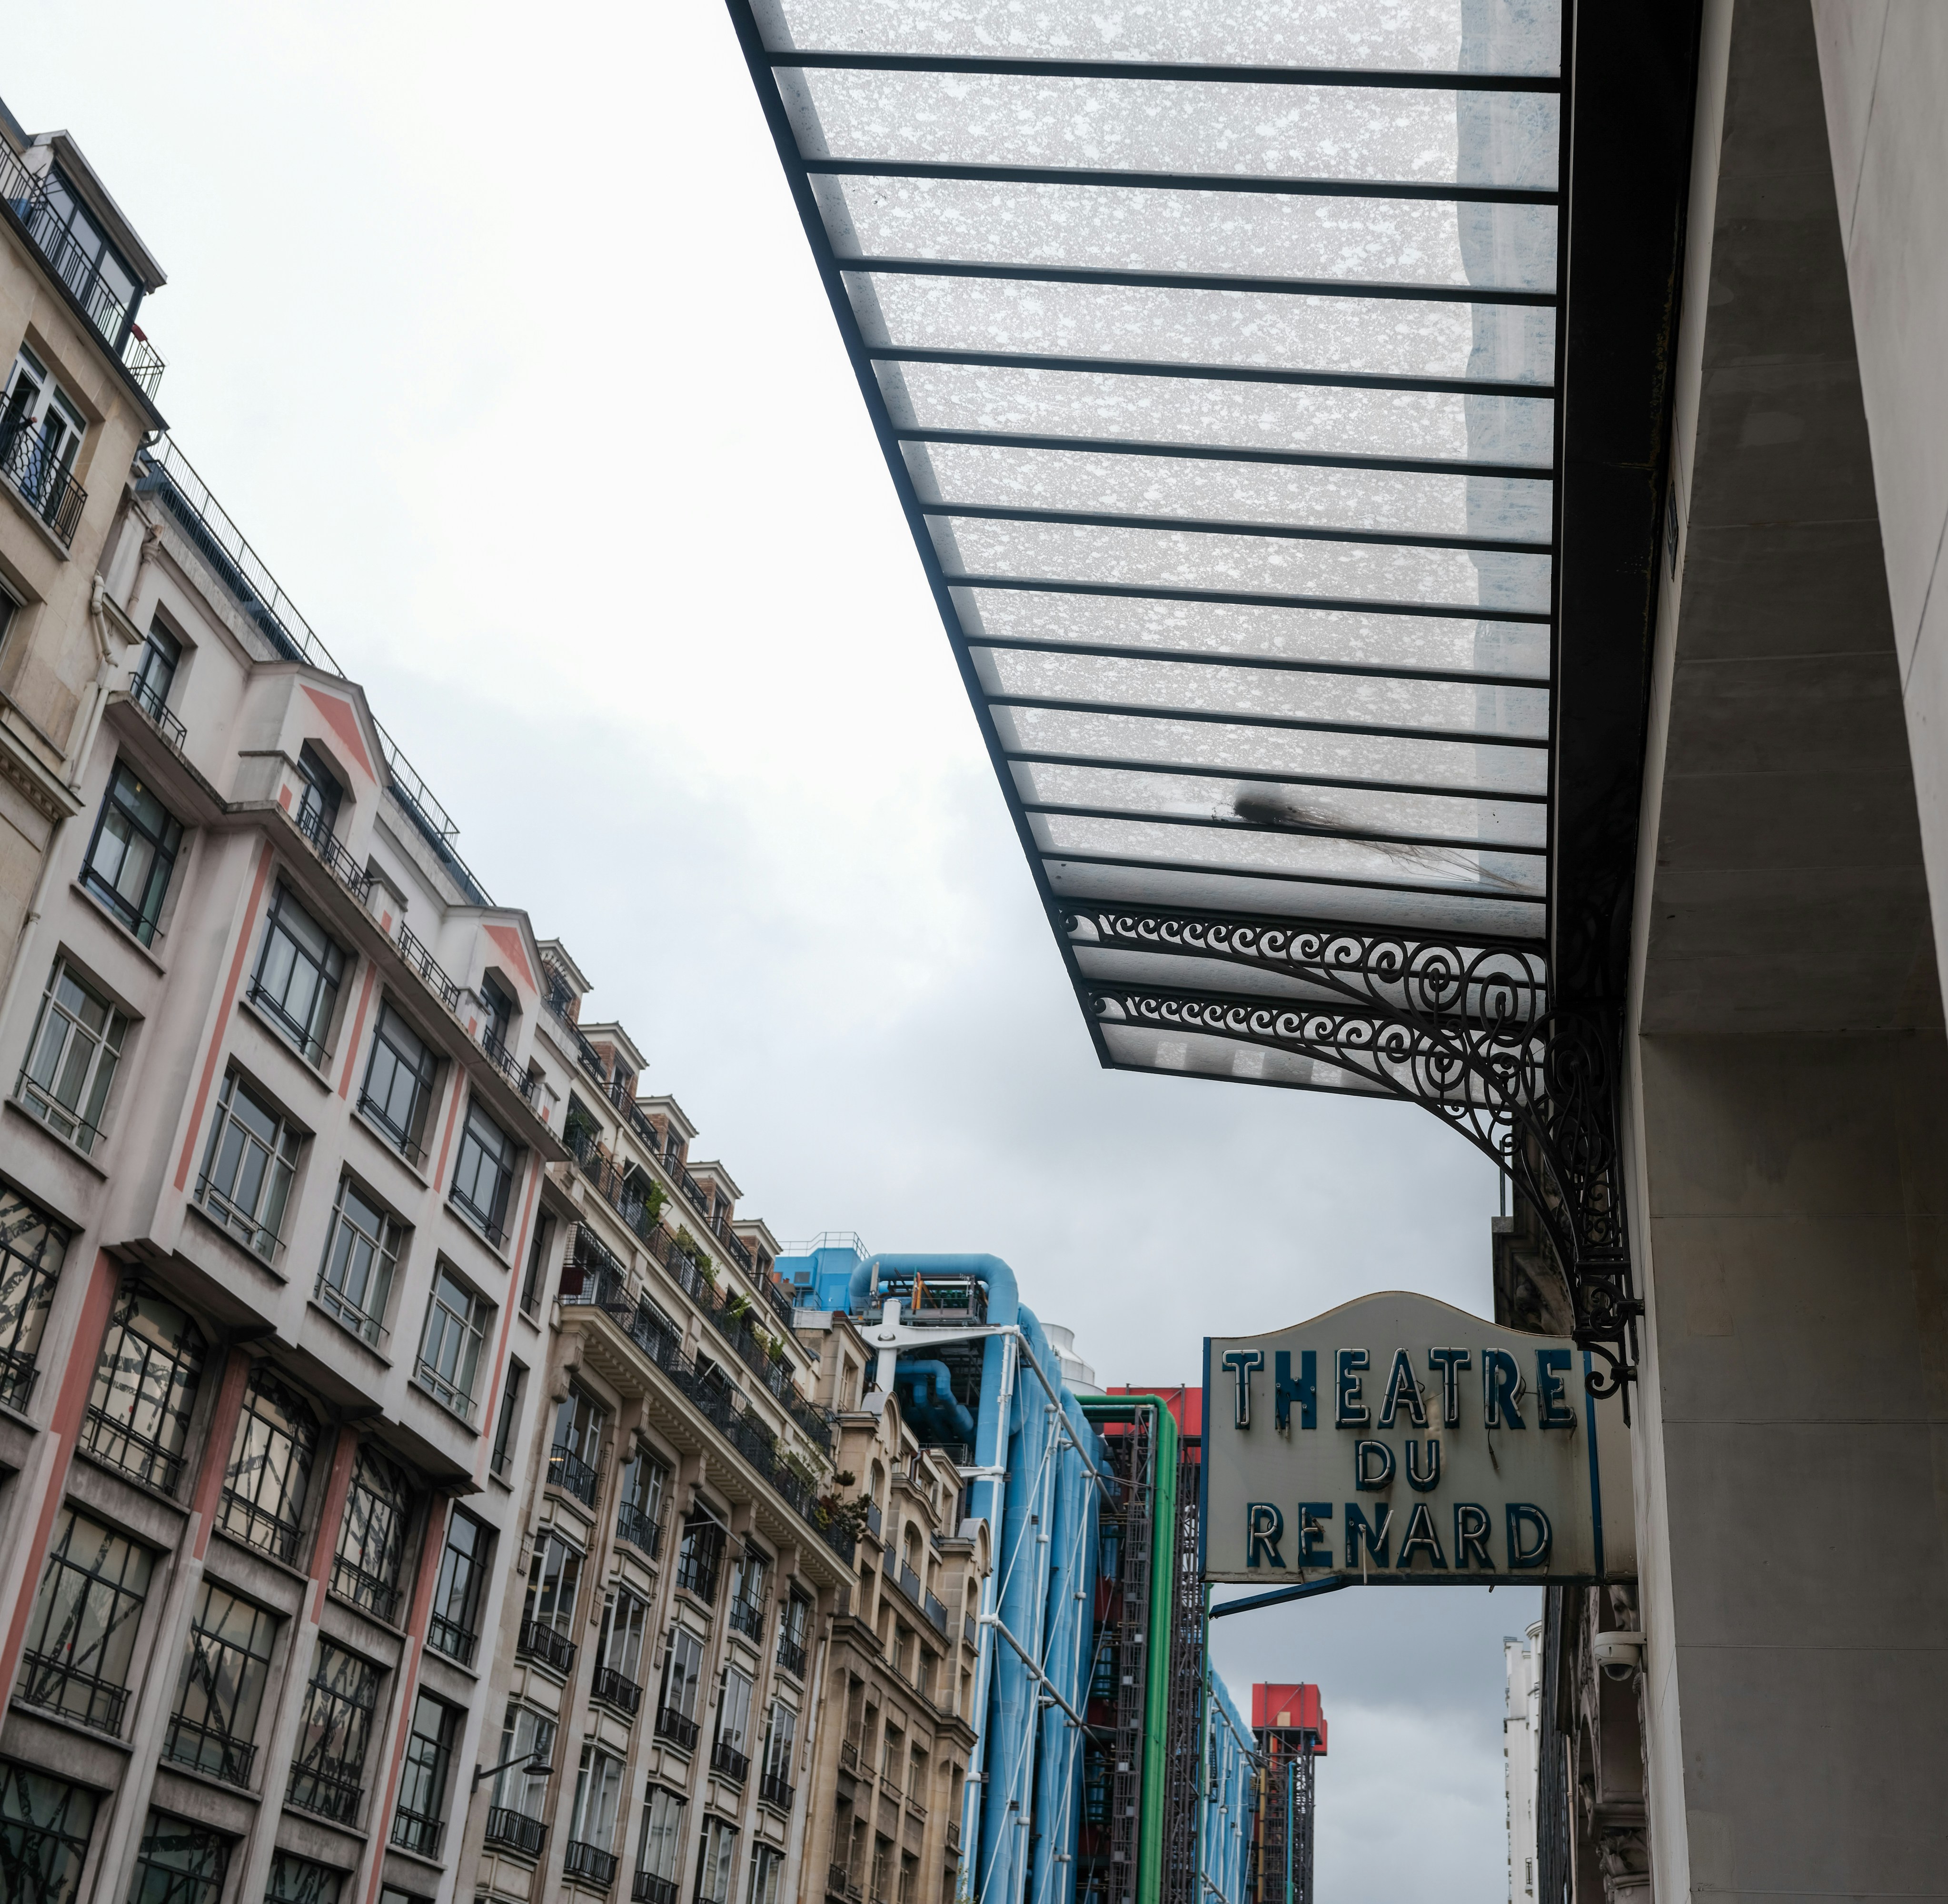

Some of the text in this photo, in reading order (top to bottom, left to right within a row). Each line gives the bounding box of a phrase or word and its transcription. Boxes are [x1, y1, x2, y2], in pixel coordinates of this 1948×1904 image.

[1222, 1347, 1574, 1429] THEATRE
[1355, 1439, 1440, 1491] DU
[1246, 1502, 1553, 1569] RENARD
